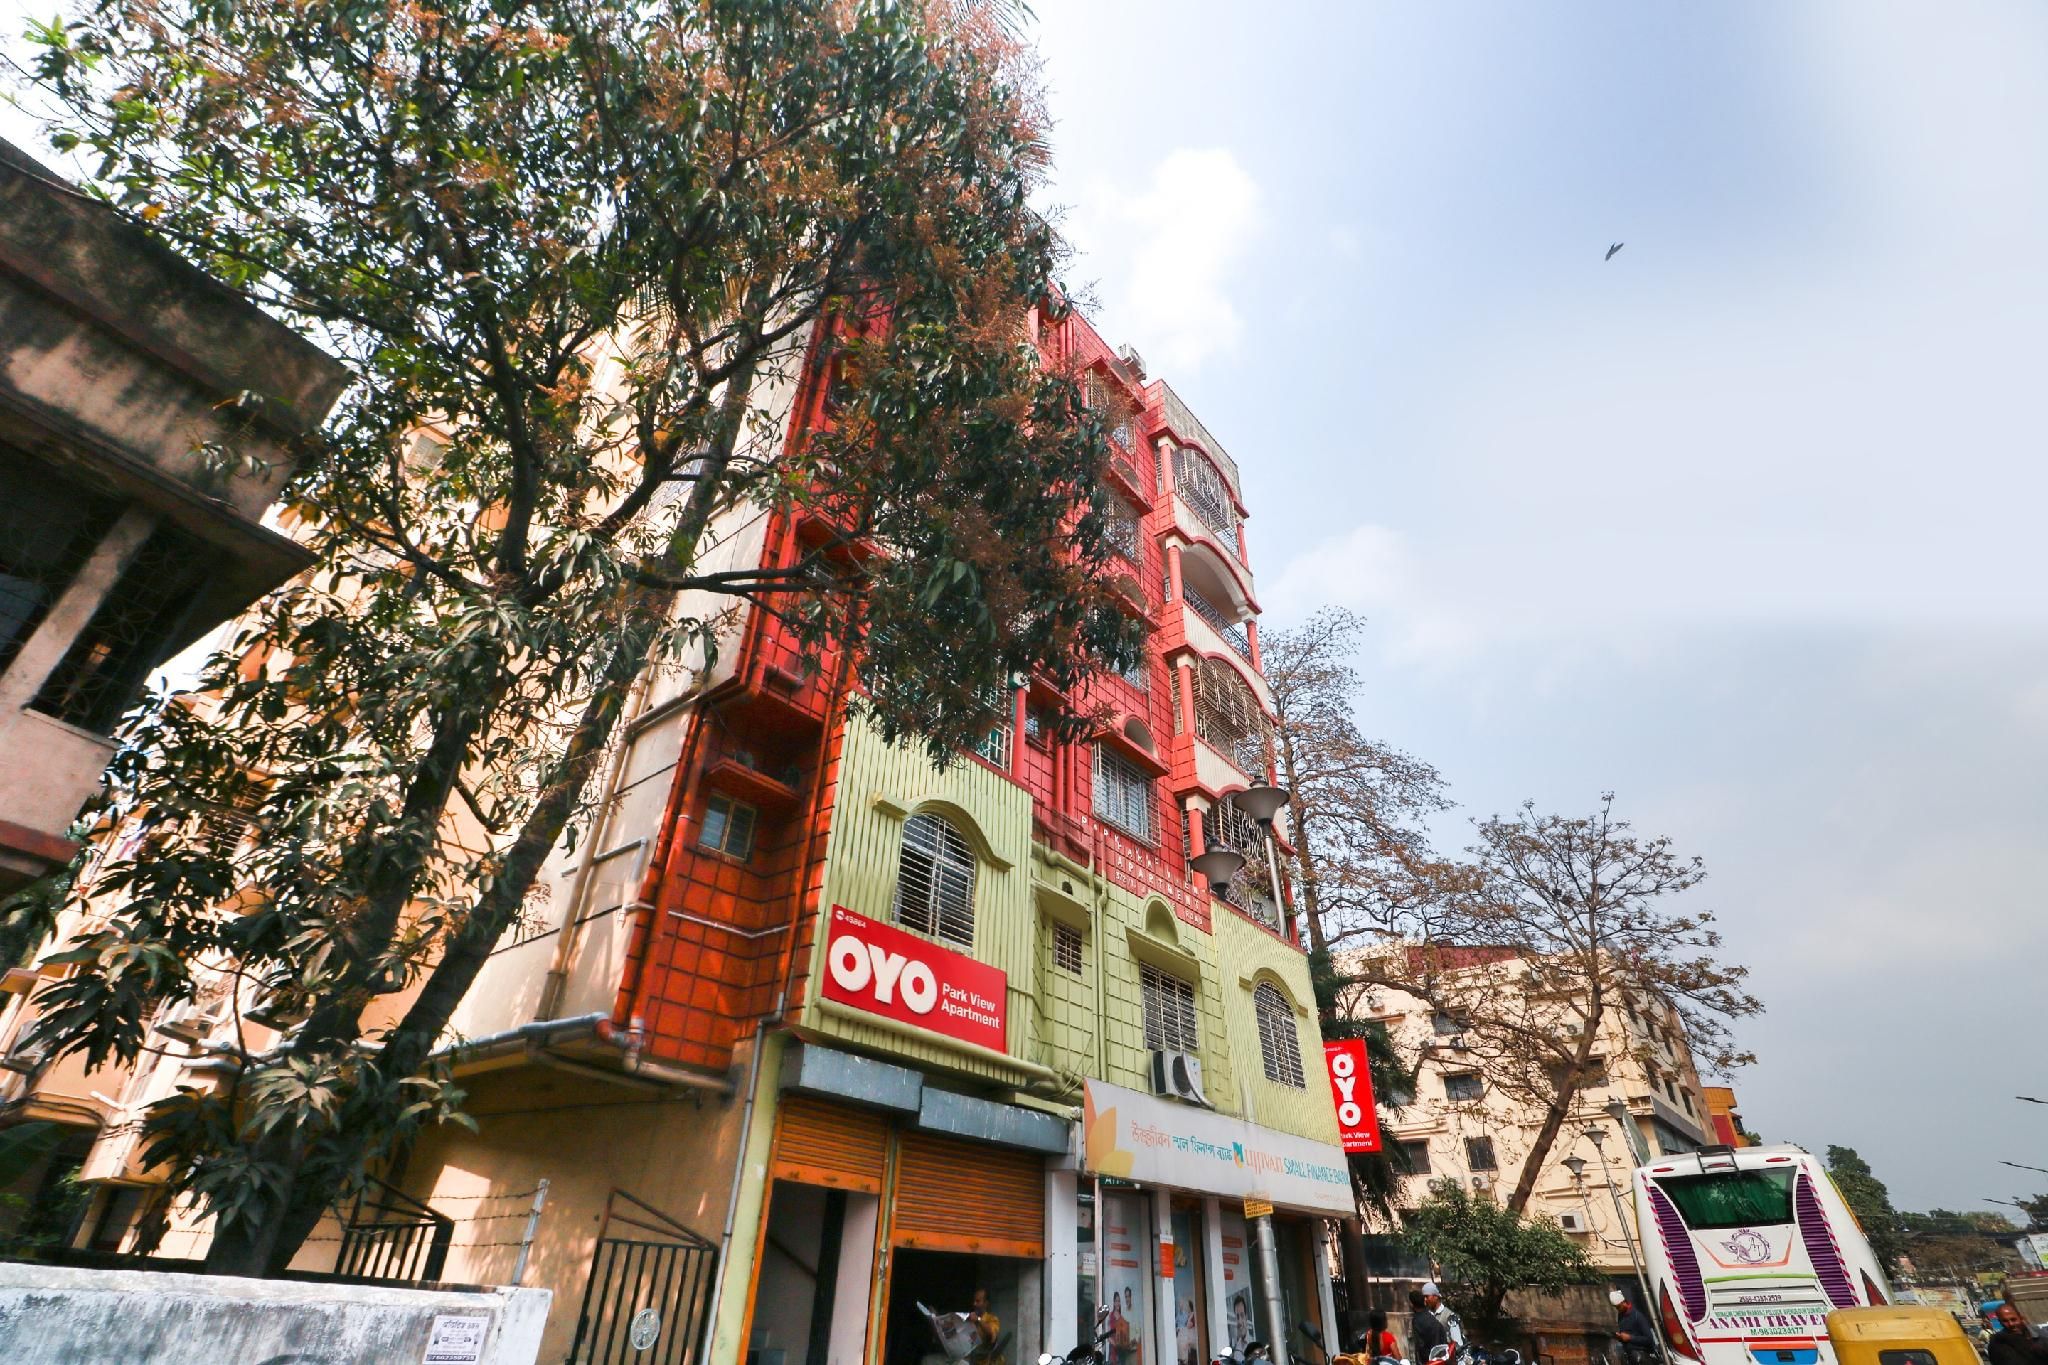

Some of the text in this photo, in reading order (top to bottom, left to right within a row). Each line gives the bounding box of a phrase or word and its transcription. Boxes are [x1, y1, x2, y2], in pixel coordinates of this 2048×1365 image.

[829, 935, 938, 1015] OYO
[942, 982, 996, 1012] Park View
[941, 998, 1000, 1029] Apartment
[1332, 1053, 1361, 1126] OYO
[1709, 1316, 1761, 1329] ANAMI
